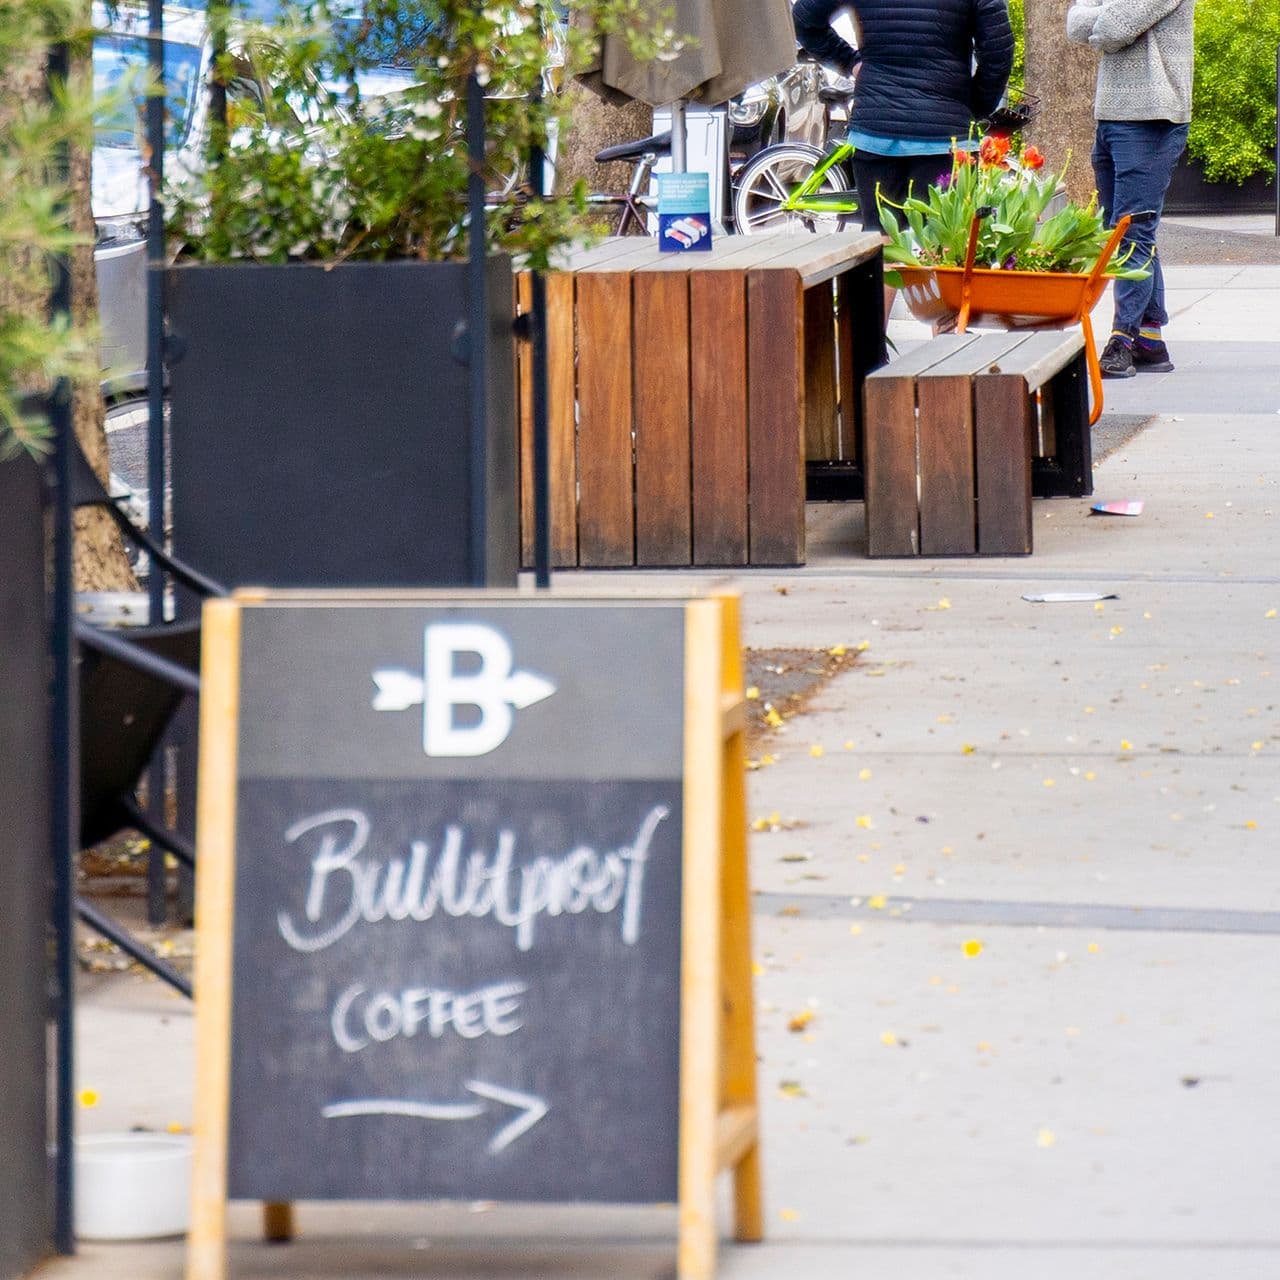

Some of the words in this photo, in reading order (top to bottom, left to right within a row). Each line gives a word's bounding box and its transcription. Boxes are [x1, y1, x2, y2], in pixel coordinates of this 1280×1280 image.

[422, 622, 514, 758] B
[277, 804, 671, 953] Bulletproof
[329, 980, 528, 1052] COFFEE
